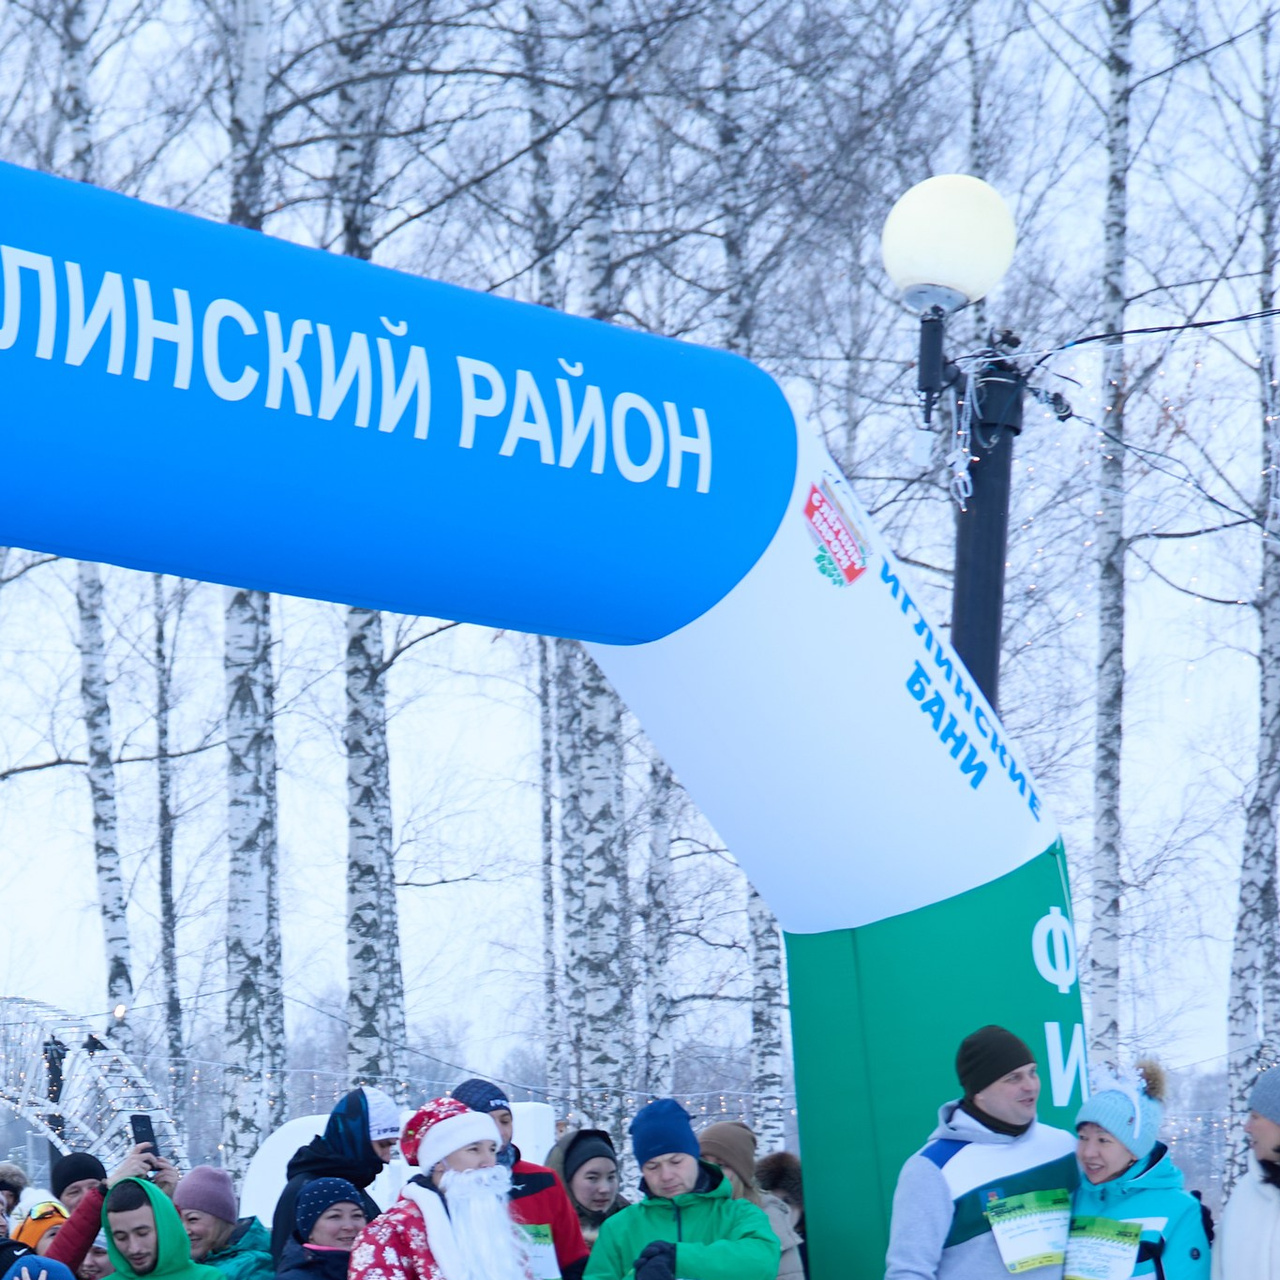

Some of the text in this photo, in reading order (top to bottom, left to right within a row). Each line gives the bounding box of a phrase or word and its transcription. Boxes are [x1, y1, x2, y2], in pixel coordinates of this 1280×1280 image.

[455, 356, 713, 494] РАЙОН
[880, 554, 1042, 822] ИГЛИНСКИЕ
[905, 660, 988, 790] БАНИ
